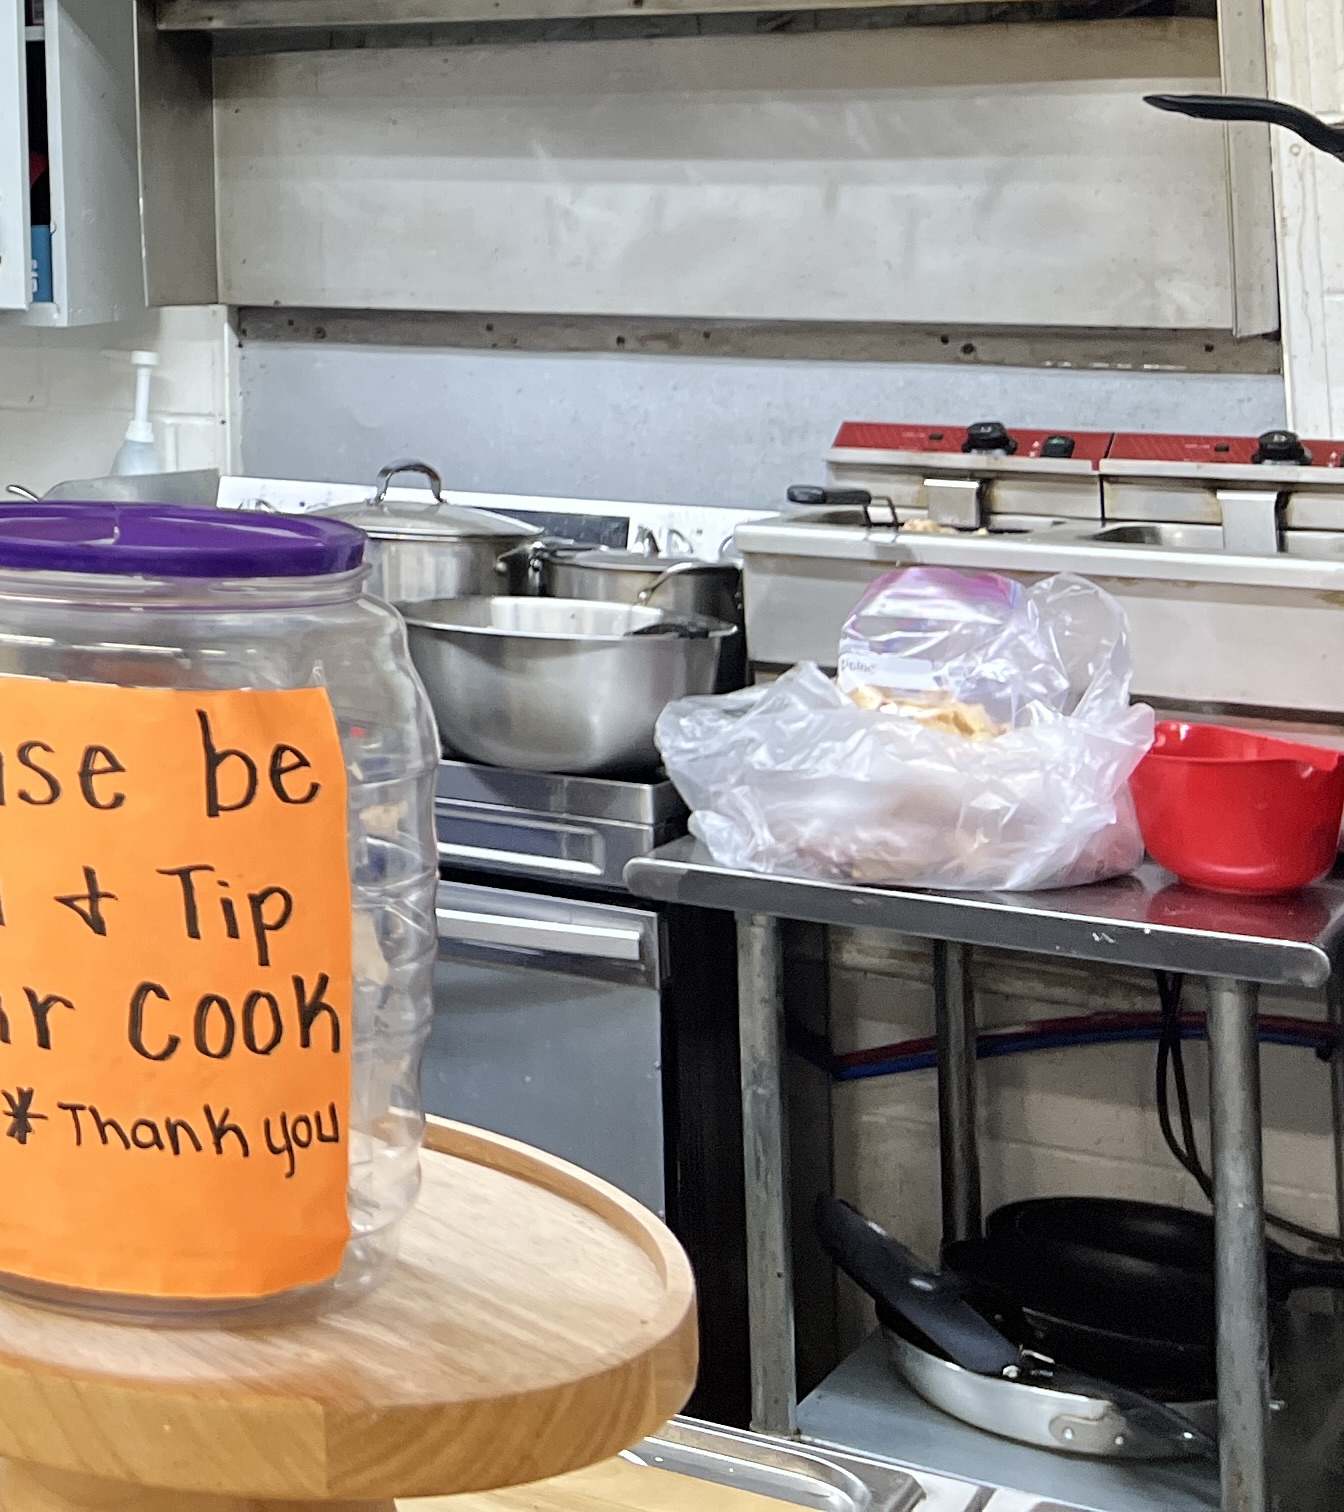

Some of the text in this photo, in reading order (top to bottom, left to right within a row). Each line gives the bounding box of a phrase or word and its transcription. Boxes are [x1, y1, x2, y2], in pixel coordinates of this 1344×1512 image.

[197, 708, 322, 818] be
[155, 863, 294, 968] Tip
[264, 1103, 342, 1179] you
